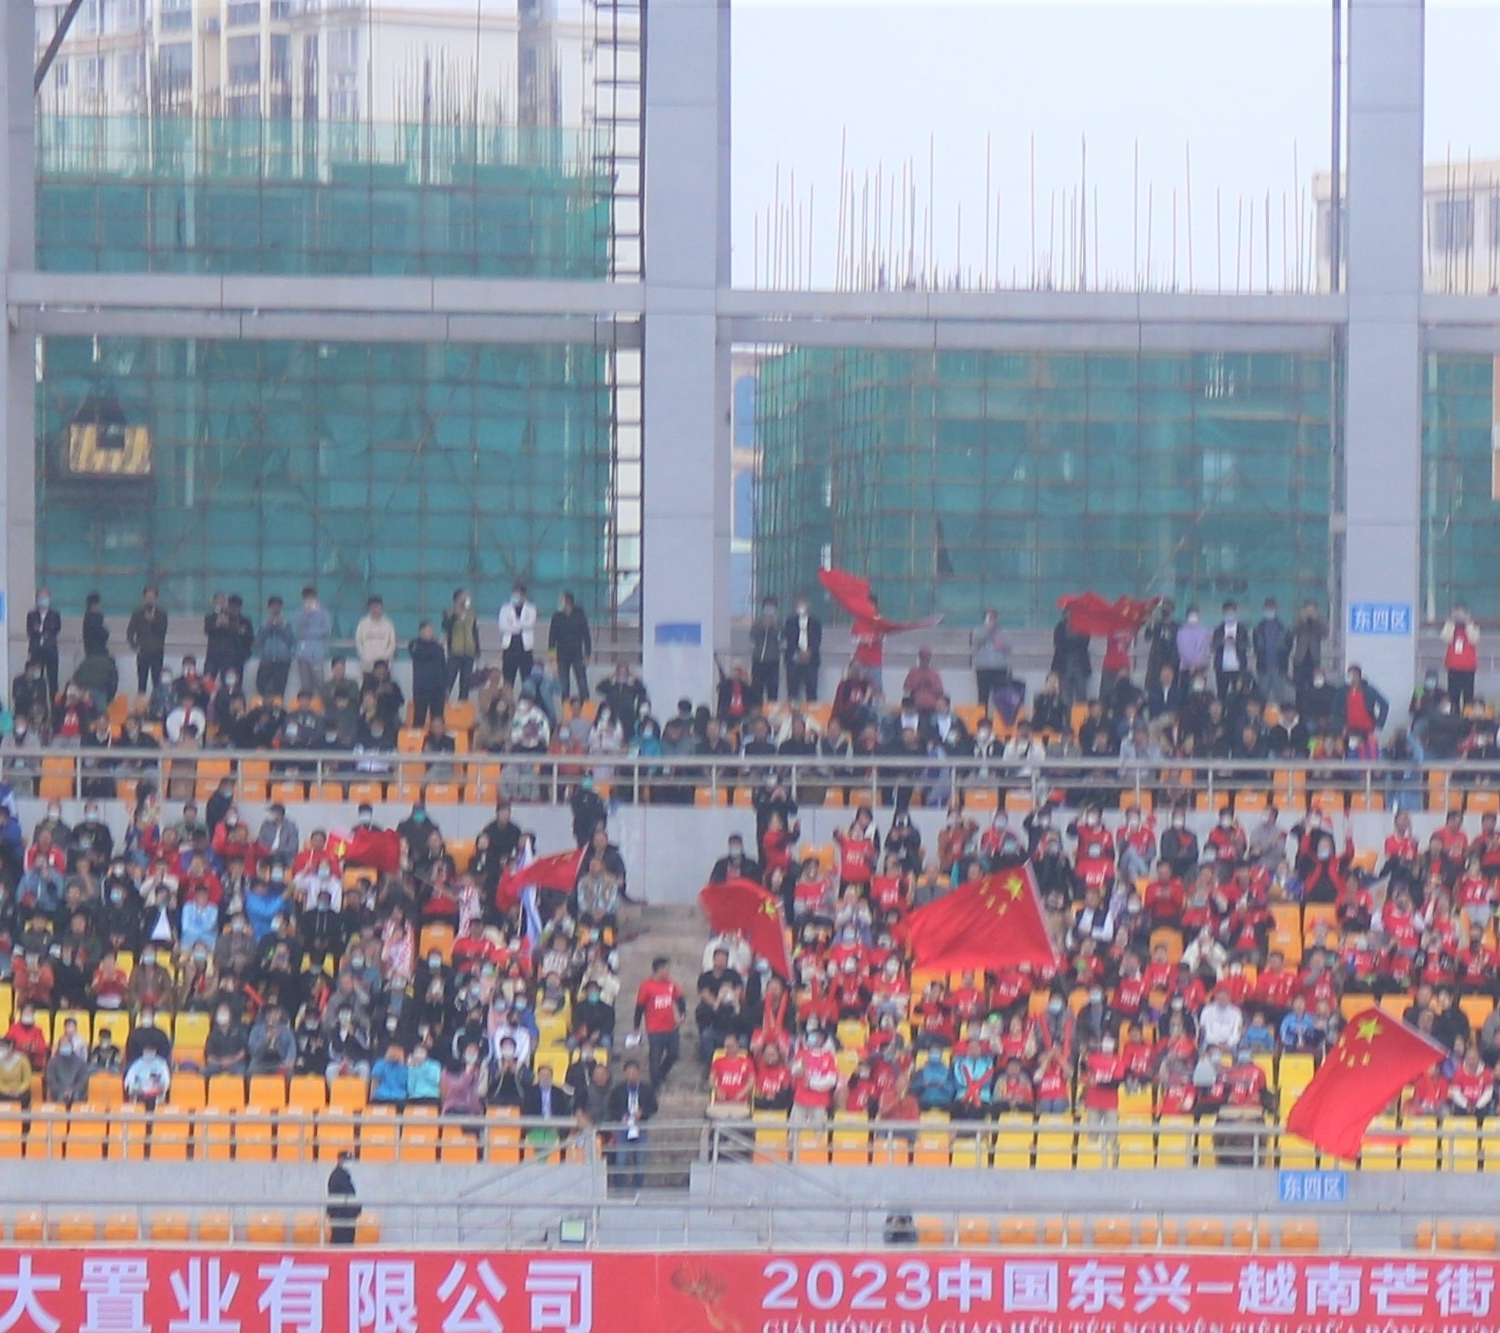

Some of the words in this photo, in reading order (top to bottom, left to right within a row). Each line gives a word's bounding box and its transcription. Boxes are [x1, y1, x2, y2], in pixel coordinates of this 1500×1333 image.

[1352, 607, 1406, 631] 东四区
[1282, 1173, 1343, 1199] 东四区
